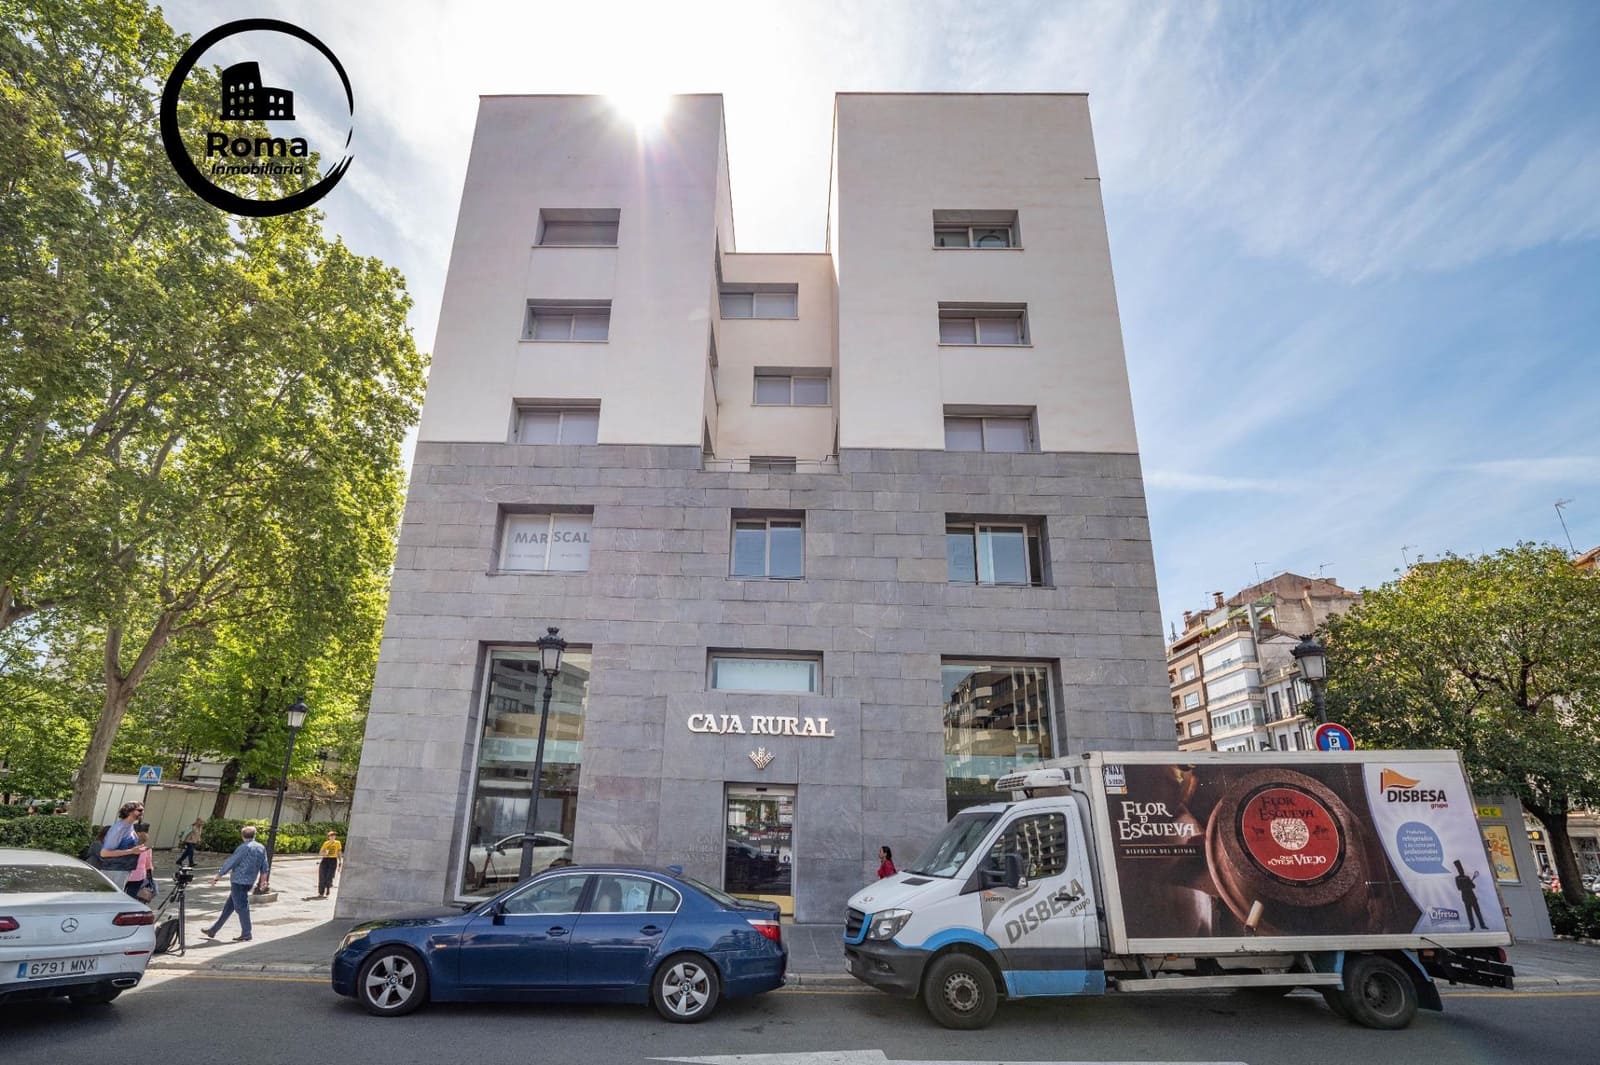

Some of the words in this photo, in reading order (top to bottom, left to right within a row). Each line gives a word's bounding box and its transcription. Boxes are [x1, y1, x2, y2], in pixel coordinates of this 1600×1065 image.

[515, 531, 590, 544] MARSCAL
[687, 713, 746, 735] CAJA
[750, 715, 835, 737] RURAL
[1330, 738, 1338, 747] P
[1387, 790, 1447, 803] DISBESA
[1120, 801, 1173, 820] FLOR
[1117, 820, 1203, 840] ESGUEVA
[1005, 879, 1085, 944] DISBESA
[1070, 898, 1091, 917] grupo
[31, 961, 65, 975] 6791
[70, 959, 95, 972] MNX
